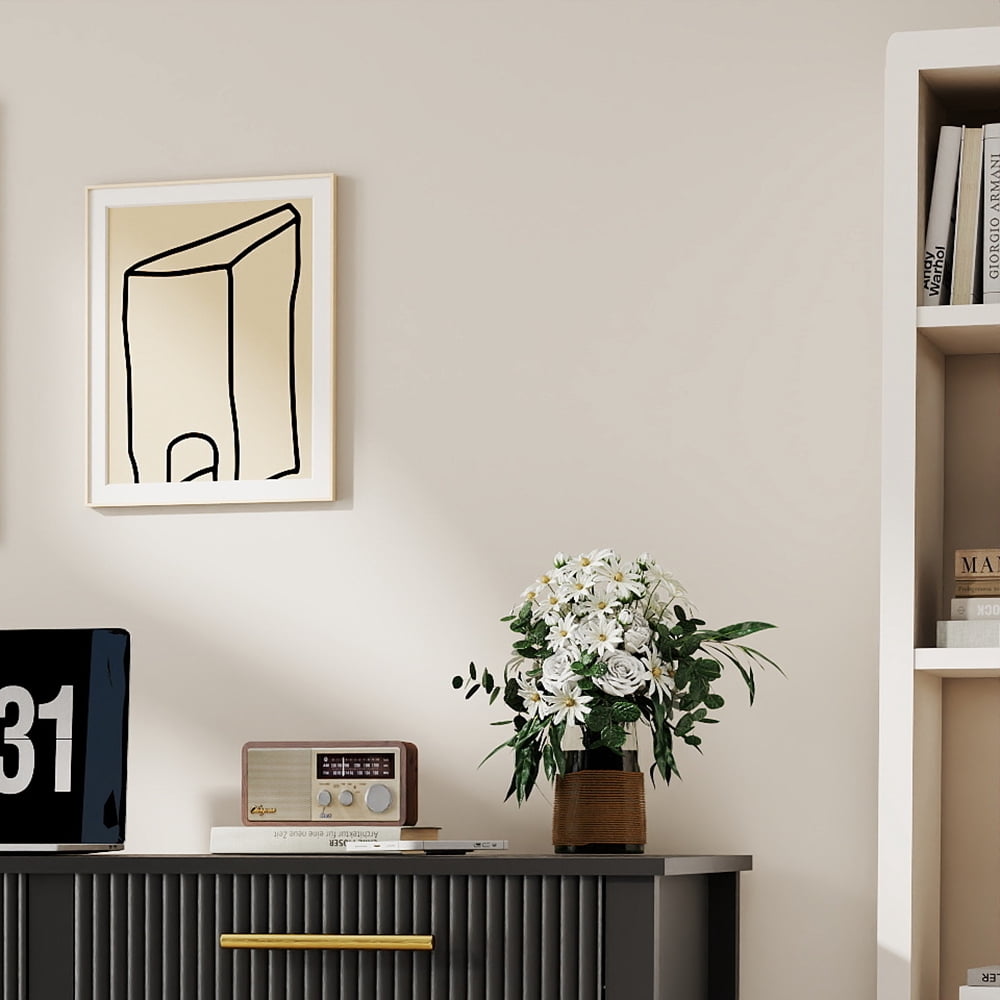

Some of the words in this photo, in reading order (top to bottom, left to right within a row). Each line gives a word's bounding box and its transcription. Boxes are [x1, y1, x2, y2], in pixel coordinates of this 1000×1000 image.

[990, 153, 1000, 211] ARMANI
[989, 217, 1000, 279] GIORGIO
[923, 251, 936, 290] Andy
[929, 246, 945, 297] Warhol
[961, 556, 1000, 574] MA
[274, 831, 288, 839] Zeit
[308, 831, 324, 839] eine
[338, 830, 379, 839] Architektur
